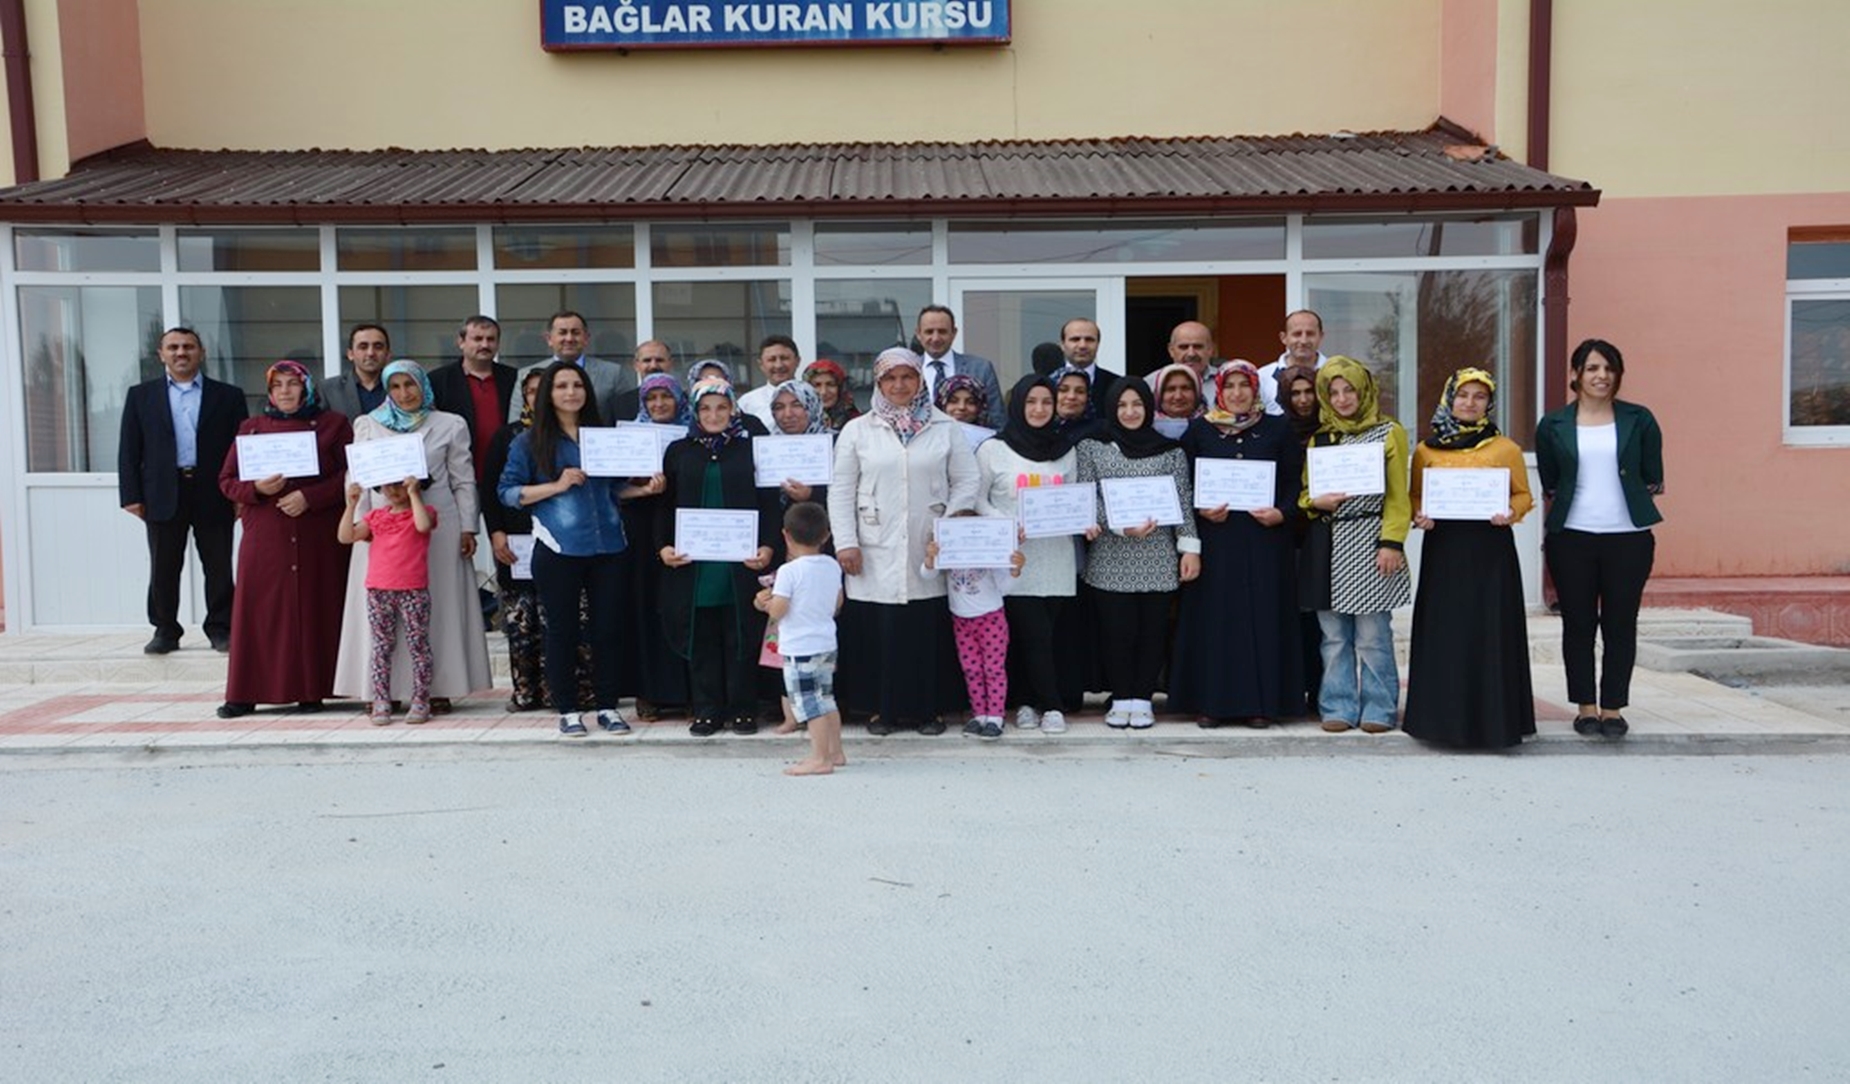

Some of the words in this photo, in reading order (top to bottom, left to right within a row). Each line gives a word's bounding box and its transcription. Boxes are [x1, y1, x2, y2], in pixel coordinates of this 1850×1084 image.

[564, 0, 712, 33] BAĞLAR
[724, 3, 853, 32] KURAN
[866, 1, 992, 30] KURSU
